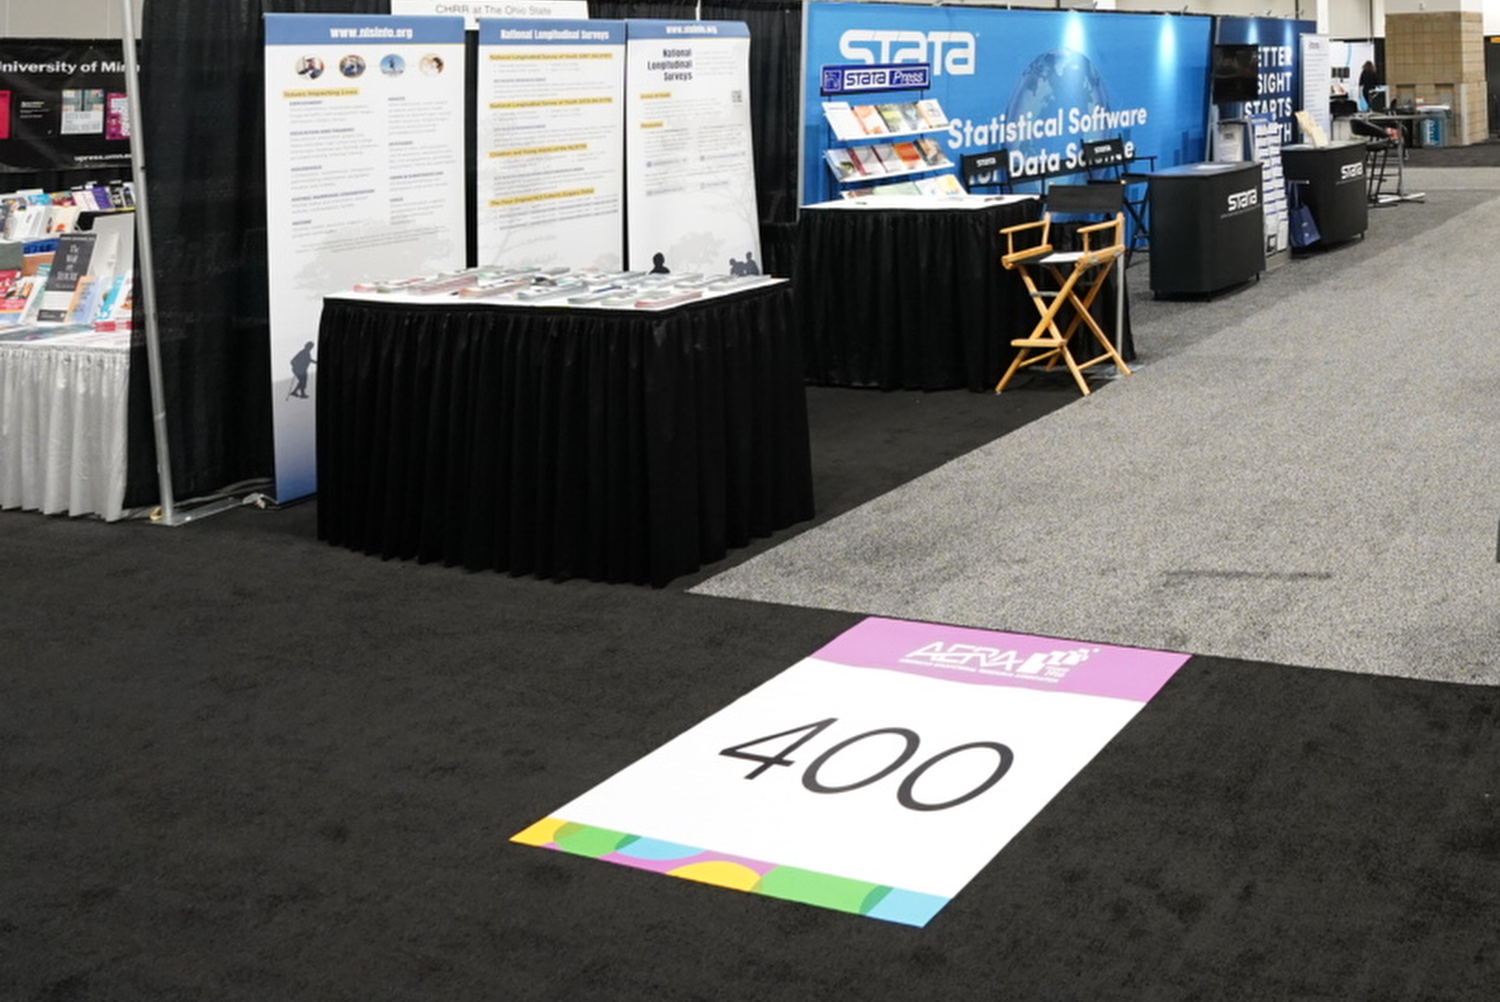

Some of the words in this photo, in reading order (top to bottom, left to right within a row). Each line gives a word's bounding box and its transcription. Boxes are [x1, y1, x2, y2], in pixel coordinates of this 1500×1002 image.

[472, 4, 483, 14] at
[484, 4, 502, 15] The
[504, 4, 527, 16] Ohio
[529, 6, 552, 17] State
[500, 29, 533, 40] National
[534, 29, 580, 40] Longitudinal
[581, 30, 610, 41] Surveys
[663, 49, 692, 58] National
[1258, 46, 1293, 67] ETTER
[80, 61, 98, 72] of
[647, 60, 693, 71] Longitudinal
[664, 72, 693, 81] Surveys
[892, 69, 925, 84] Press
[1257, 72, 1293, 95] SIGHT
[948, 108, 1064, 149] Statistical
[1068, 105, 1148, 135] Software
[1009, 148, 1061, 178] Data
[904, 641, 1024, 671] AERA
[718, 716, 1015, 813] 400
